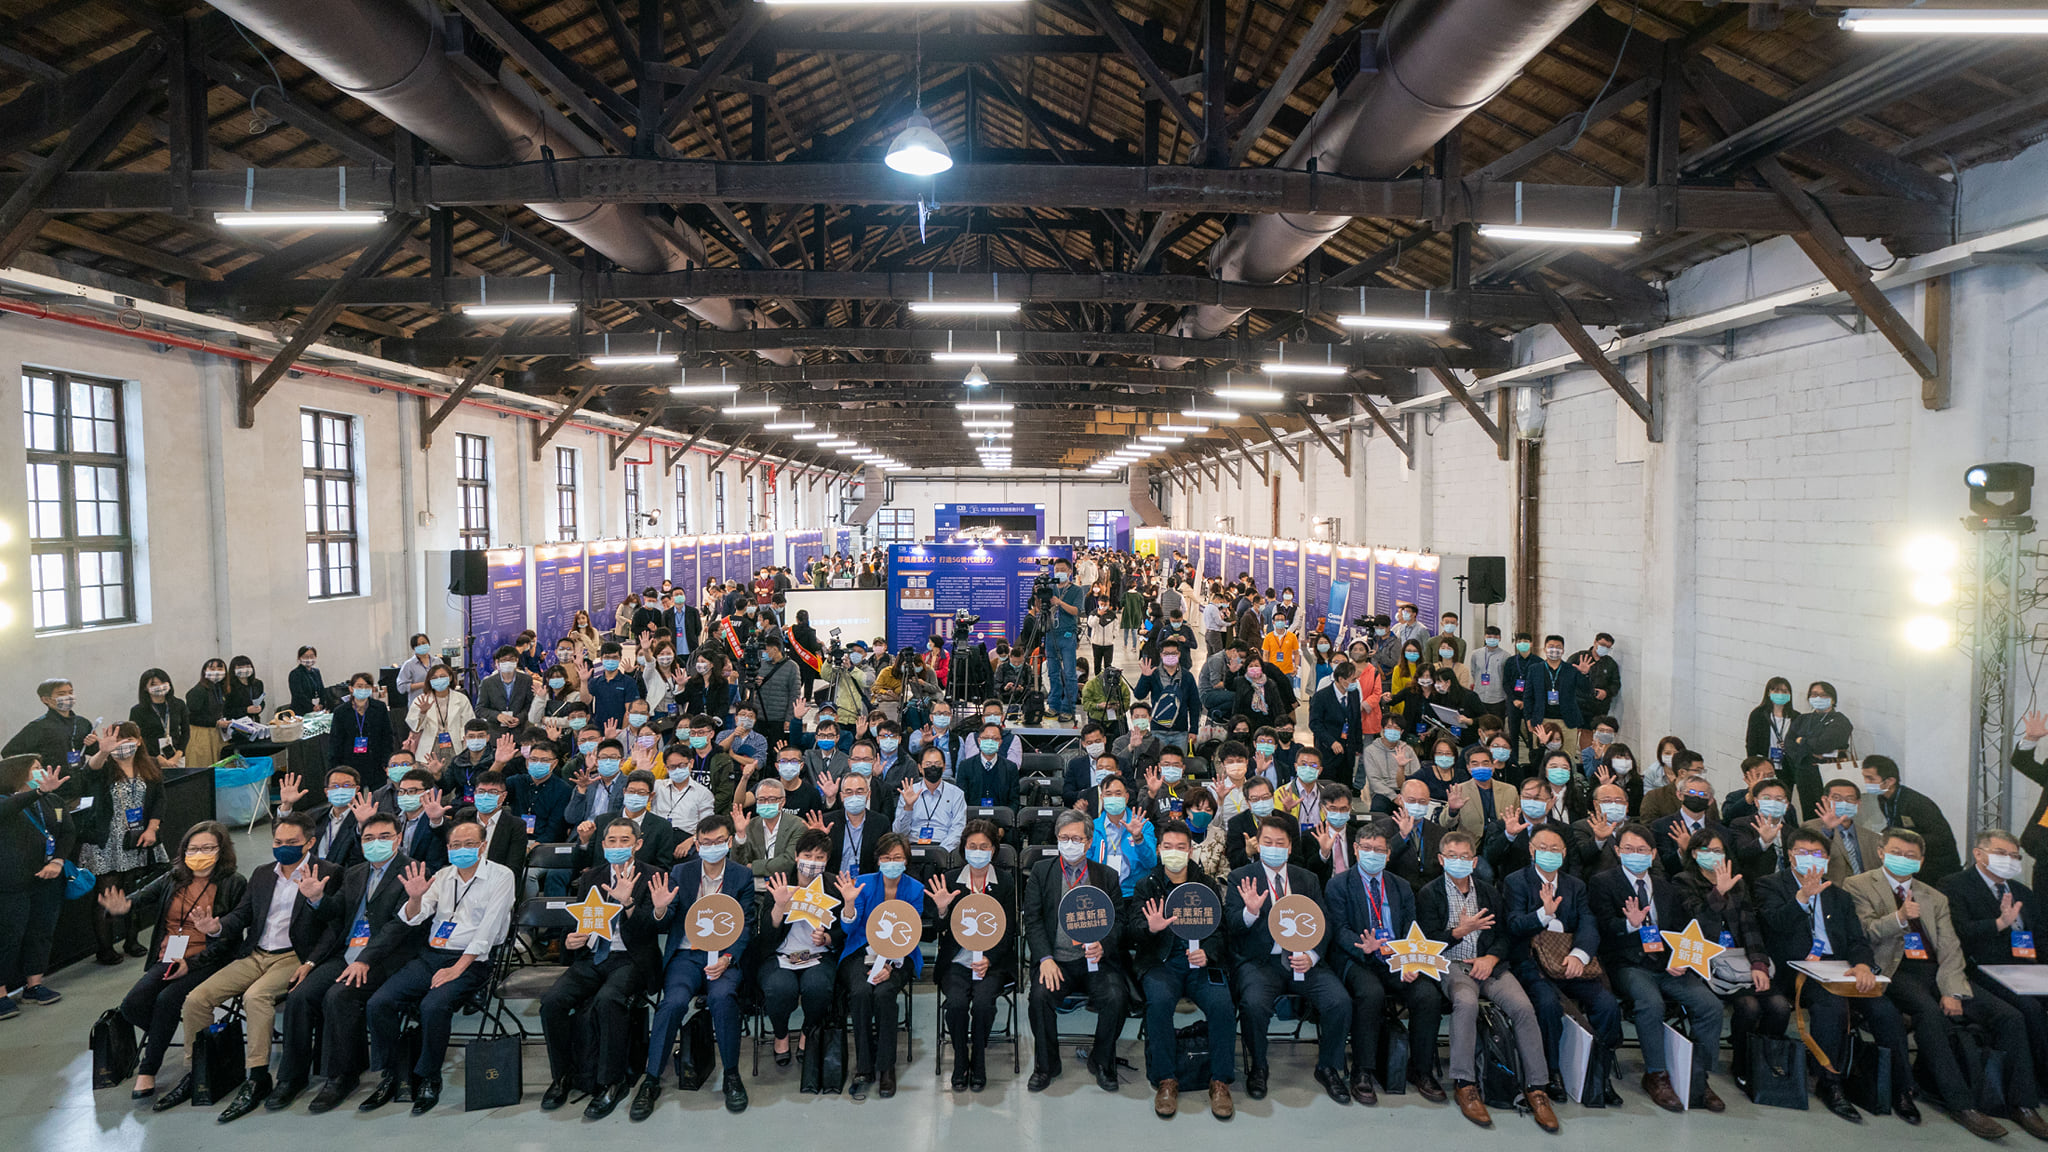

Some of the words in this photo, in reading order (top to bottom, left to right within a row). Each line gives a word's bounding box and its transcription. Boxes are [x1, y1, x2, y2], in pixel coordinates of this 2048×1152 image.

[583, 907, 604, 918] 產業
[1066, 908, 1107, 922] 產業新星
[1172, 907, 1213, 917] 產業新星
[583, 918, 604, 929] 新星
[1679, 937, 1704, 953] 產業
[1400, 954, 1436, 965] 產業新星
[1678, 949, 1703, 965] 新星
